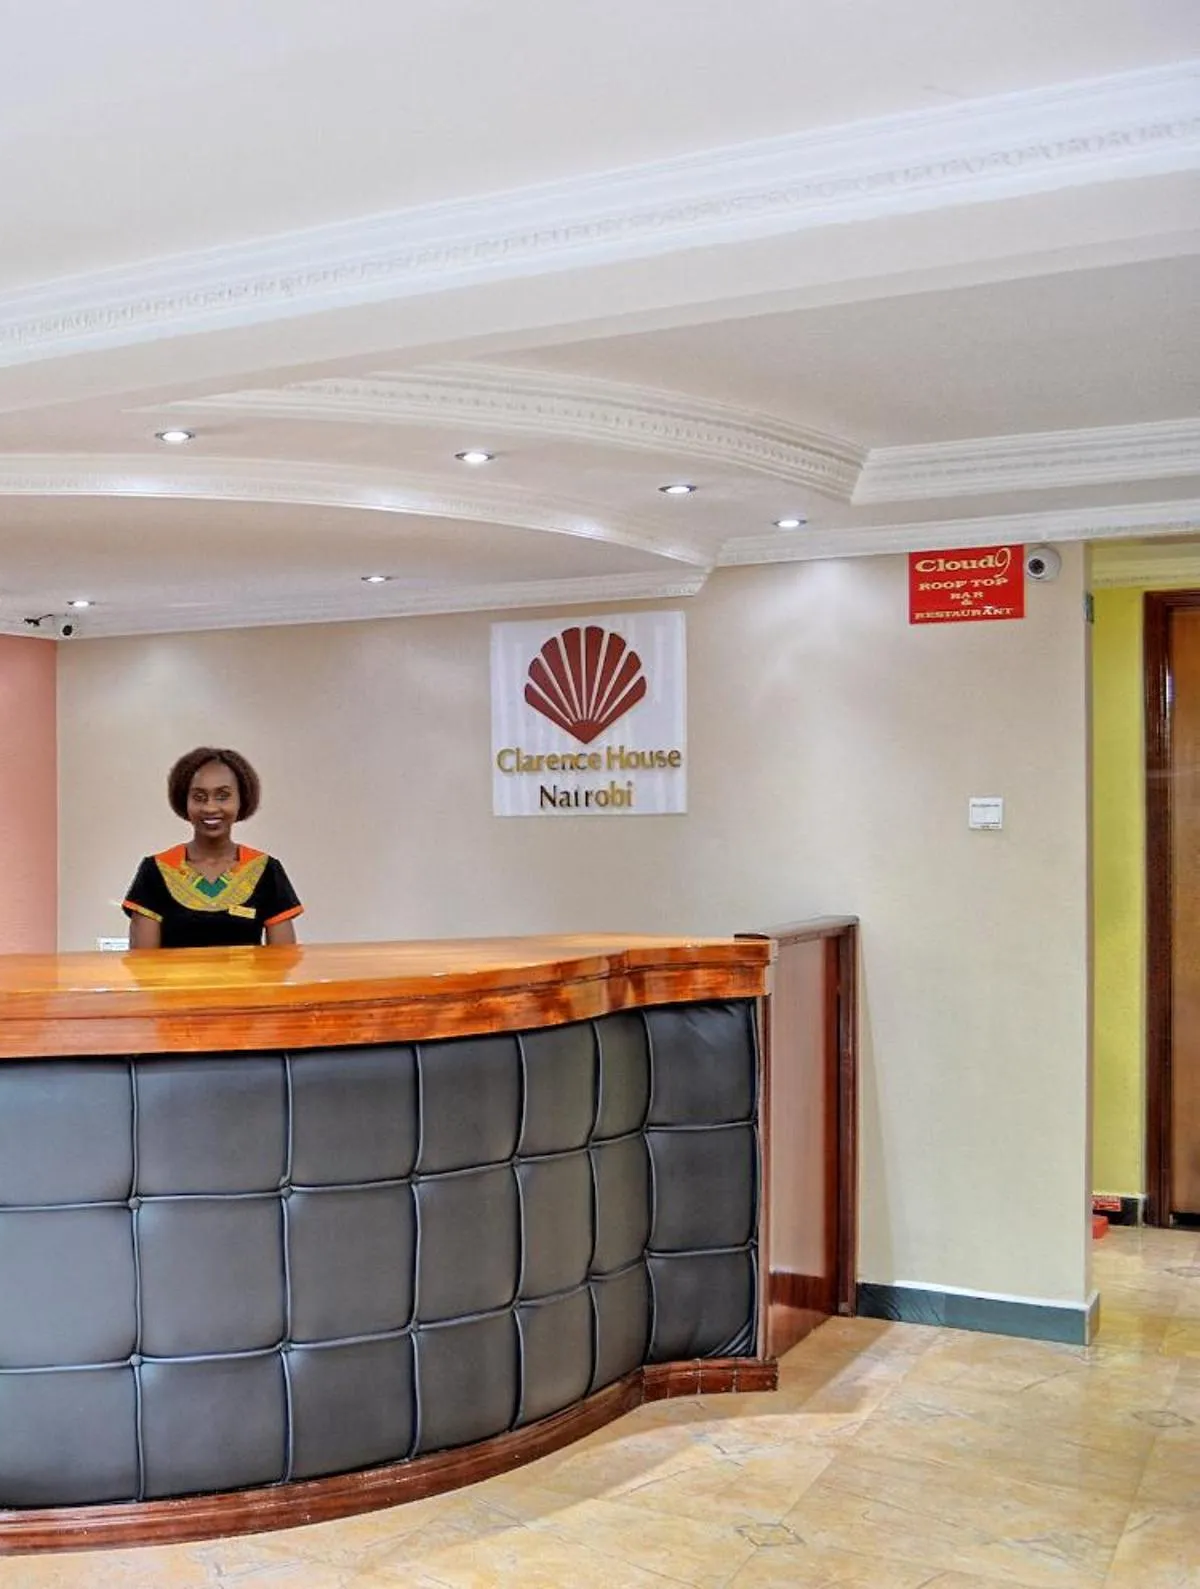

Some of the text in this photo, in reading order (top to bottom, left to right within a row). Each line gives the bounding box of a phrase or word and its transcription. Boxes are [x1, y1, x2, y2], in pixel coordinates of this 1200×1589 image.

[970, 577, 1009, 588] TOP
[496, 746, 682, 774] Clarence House
[539, 780, 634, 809] Nairobi
